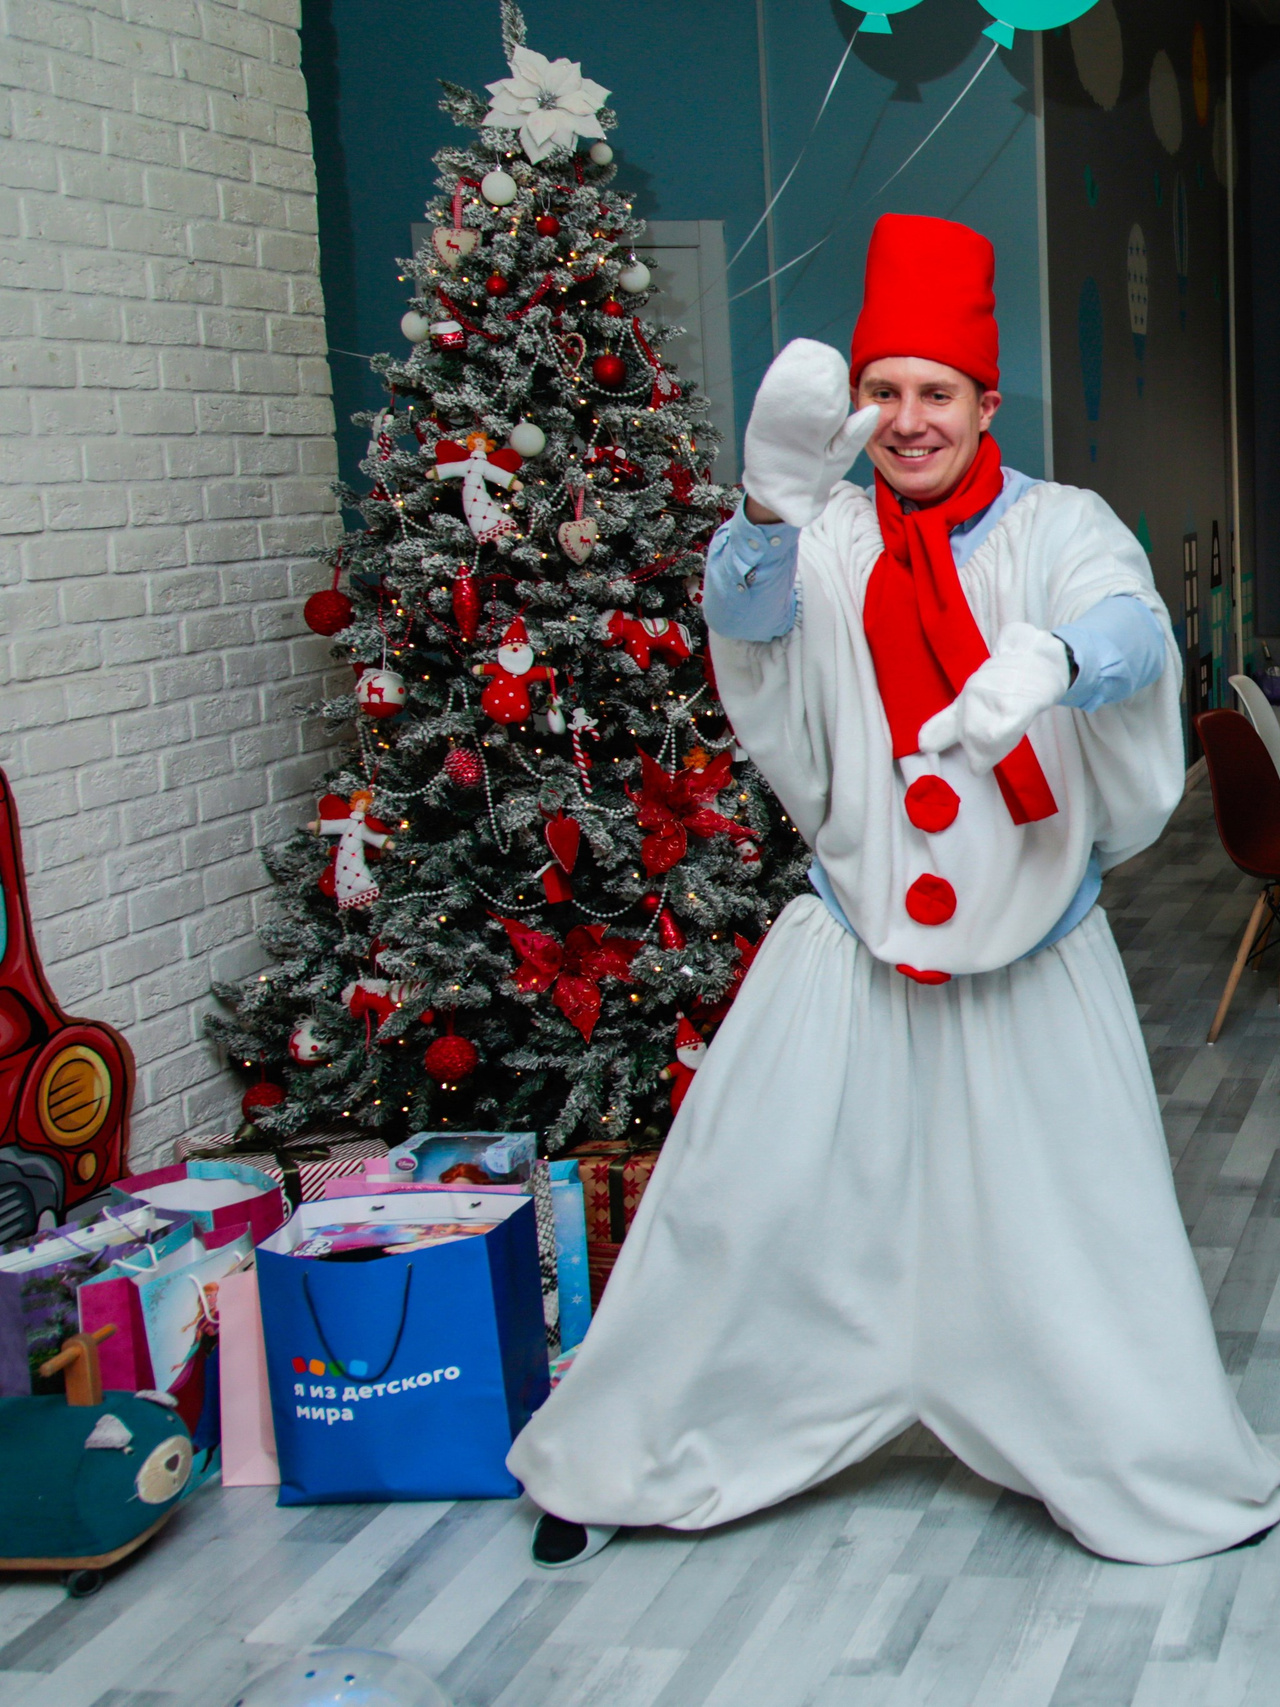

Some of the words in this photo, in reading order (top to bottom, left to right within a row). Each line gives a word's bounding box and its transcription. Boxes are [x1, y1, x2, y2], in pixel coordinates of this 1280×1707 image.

[310, 1385, 337, 1400] из
[342, 1366, 461, 1402] детского
[296, 1405, 354, 1426] мира
